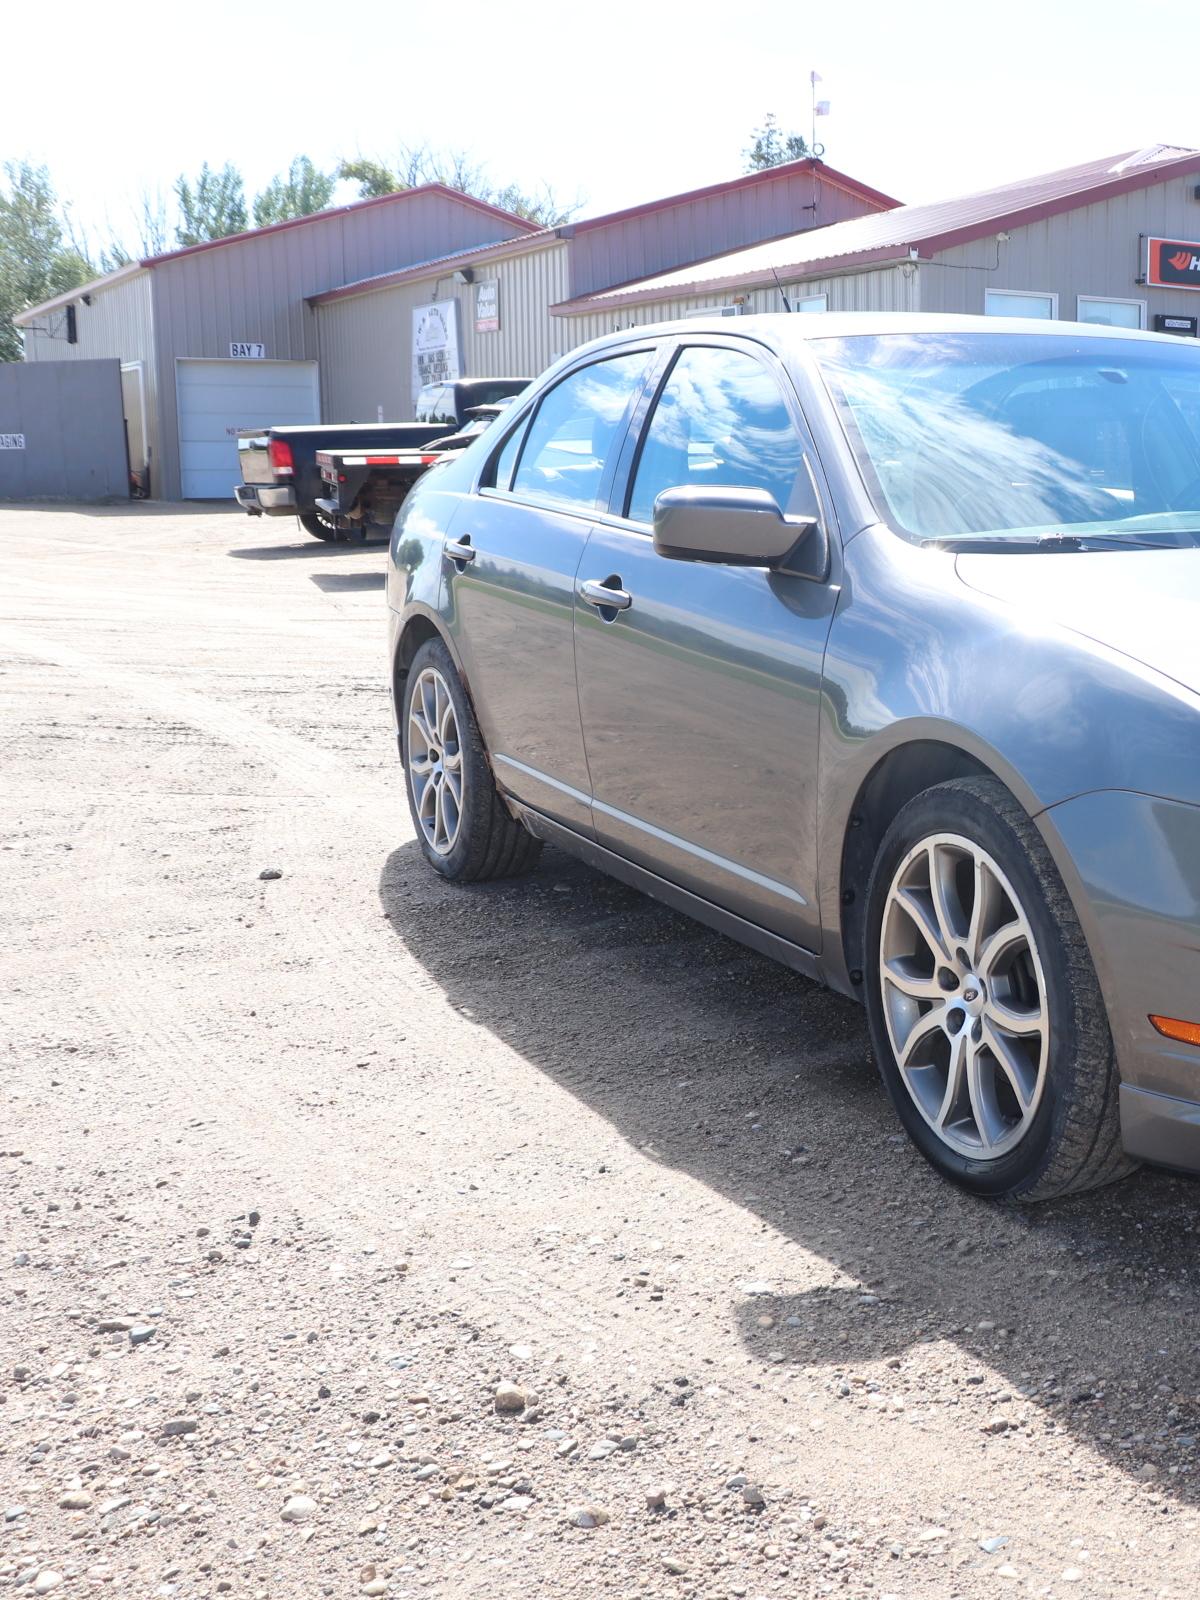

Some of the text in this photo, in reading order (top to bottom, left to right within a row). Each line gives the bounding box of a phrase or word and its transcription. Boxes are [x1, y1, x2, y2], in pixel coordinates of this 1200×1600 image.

[478, 286, 495, 302] Auto
[477, 301, 496, 318] Value
[231, 343, 262, 357] BAY 7
[226, 427, 235, 436] NO
